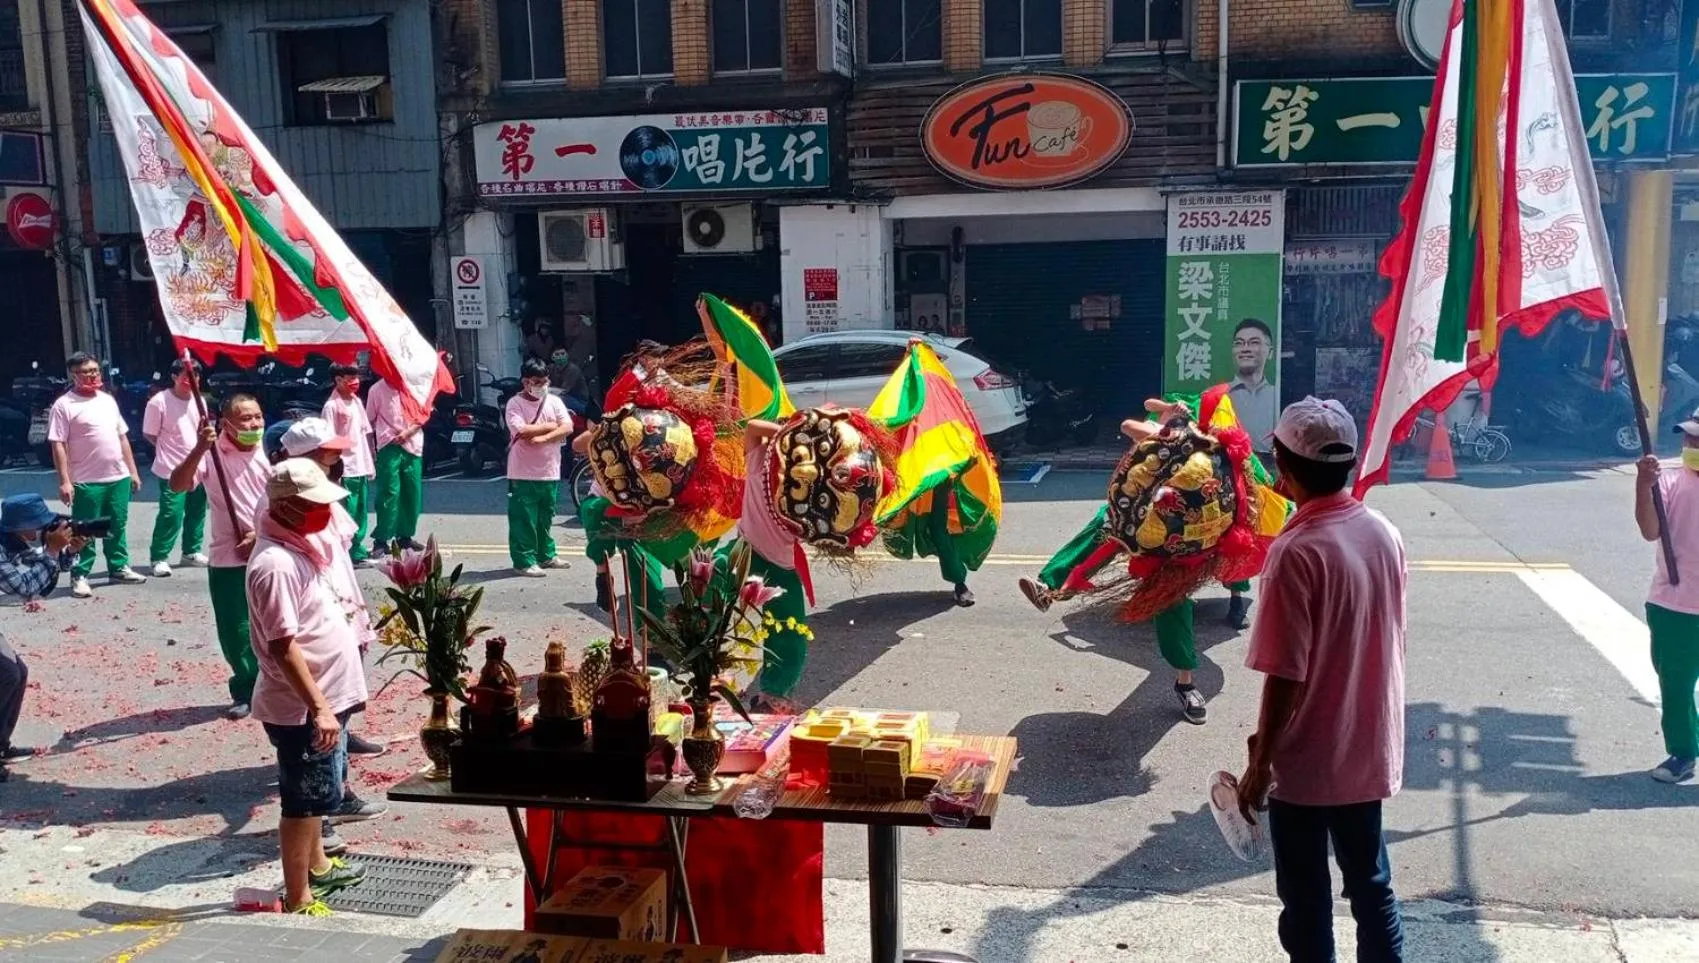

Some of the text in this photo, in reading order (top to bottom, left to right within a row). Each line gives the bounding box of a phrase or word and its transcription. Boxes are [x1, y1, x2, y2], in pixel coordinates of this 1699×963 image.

[496, 122, 824, 184] 第一 唱片行
[951, 83, 1034, 169] Fun
[1178, 209, 1272, 229] 2553-2425
[1178, 234, 1246, 252] 有事請找
[1176, 261, 1214, 381] 梁文傑
